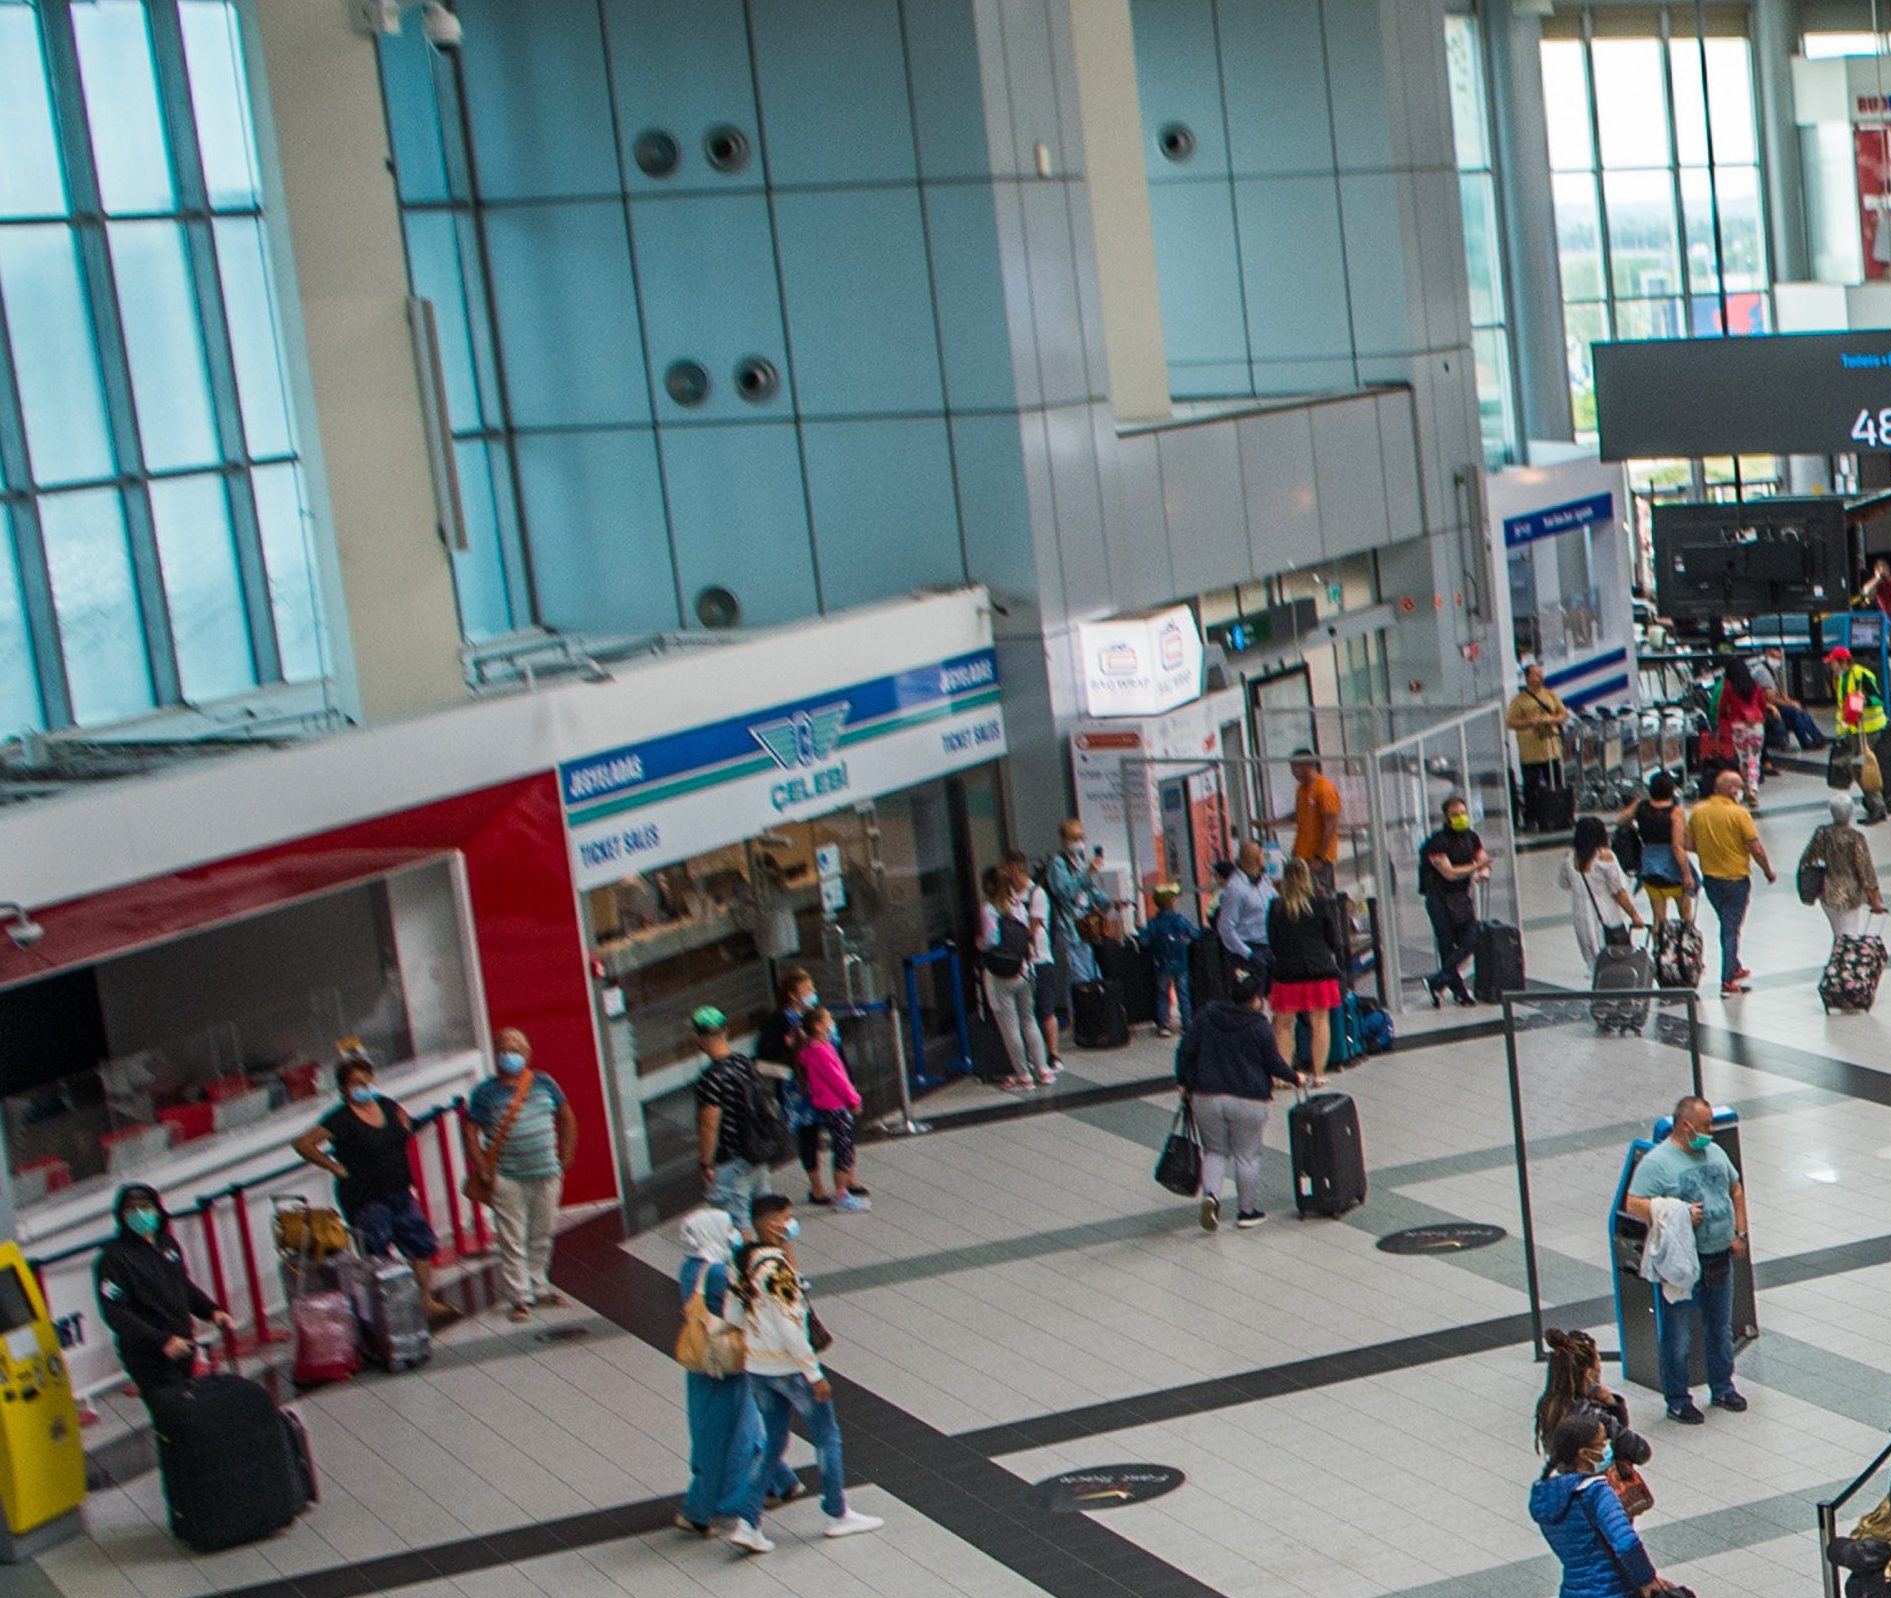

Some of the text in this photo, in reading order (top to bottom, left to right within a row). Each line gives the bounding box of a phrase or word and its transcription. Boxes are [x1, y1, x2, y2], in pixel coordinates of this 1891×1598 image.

[941, 719, 1000, 755] TICKET SALES
[580, 822, 659, 869] TICKET SALES
